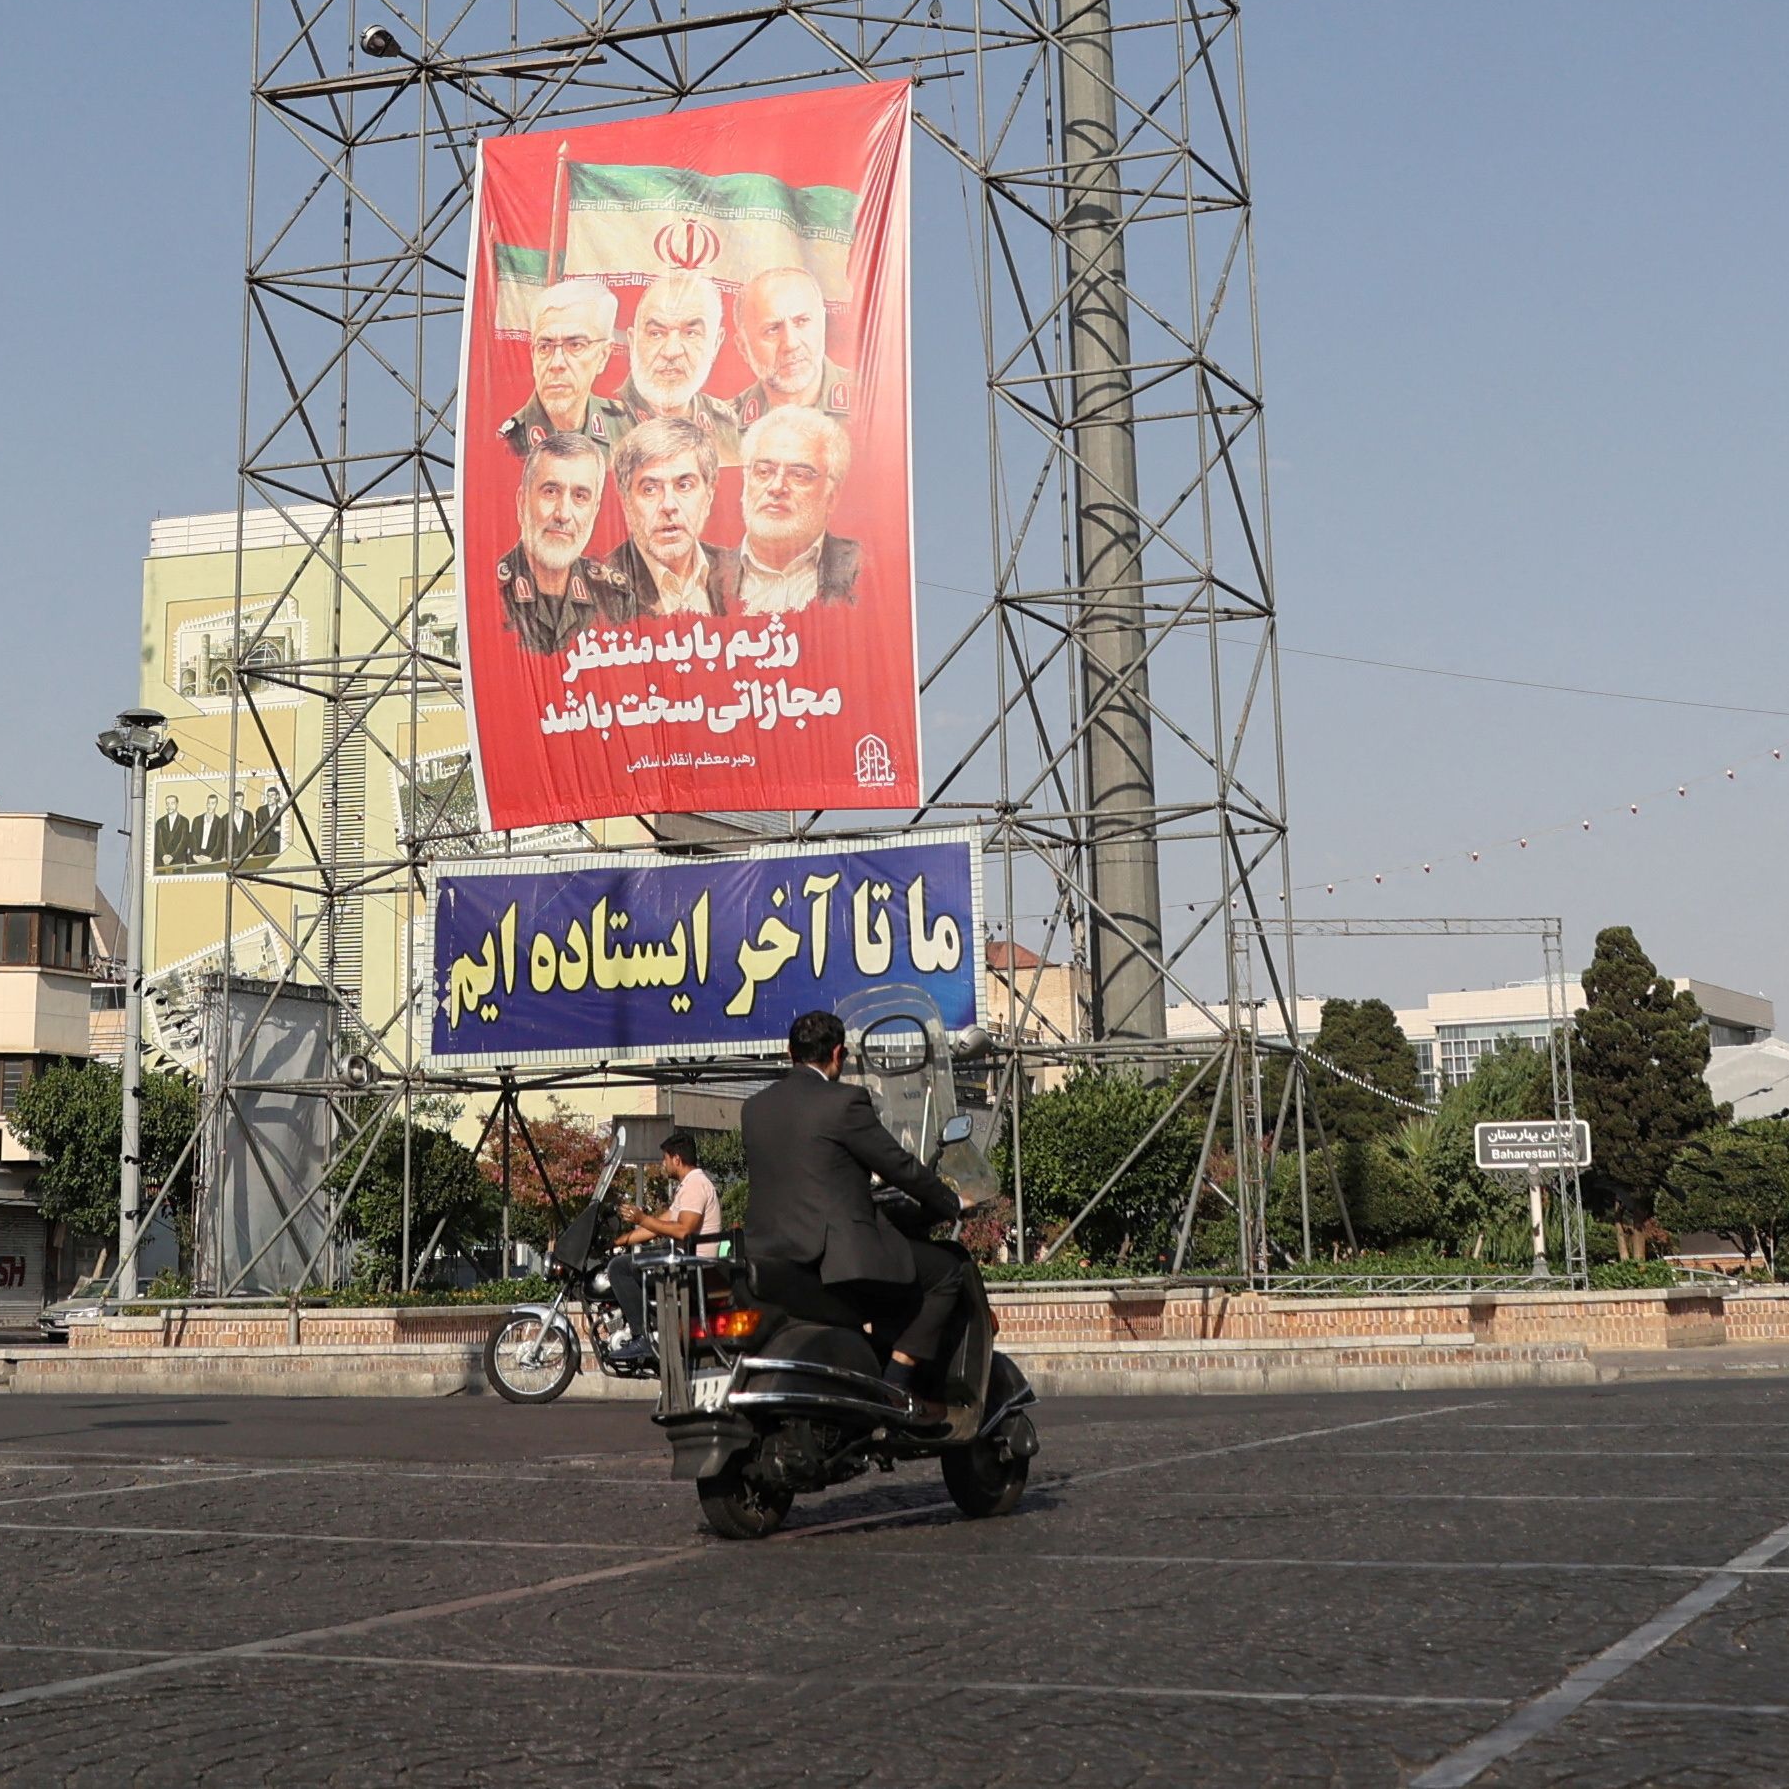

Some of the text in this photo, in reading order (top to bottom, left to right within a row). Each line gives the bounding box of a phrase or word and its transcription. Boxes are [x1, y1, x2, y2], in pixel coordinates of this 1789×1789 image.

[562, 613, 799, 683] رژیم باید منتظر
[540, 678, 842, 740] مجازاتی سخت باشد
[695, 751, 729, 769] معظم
[731, 753, 755, 768] رهبر
[449, 872, 963, 1031] ما تا آخر ایستاده ایم
[1487, 1128, 1540, 1144] بهارستان
[1491, 1148, 1556, 1160] Baharestan
